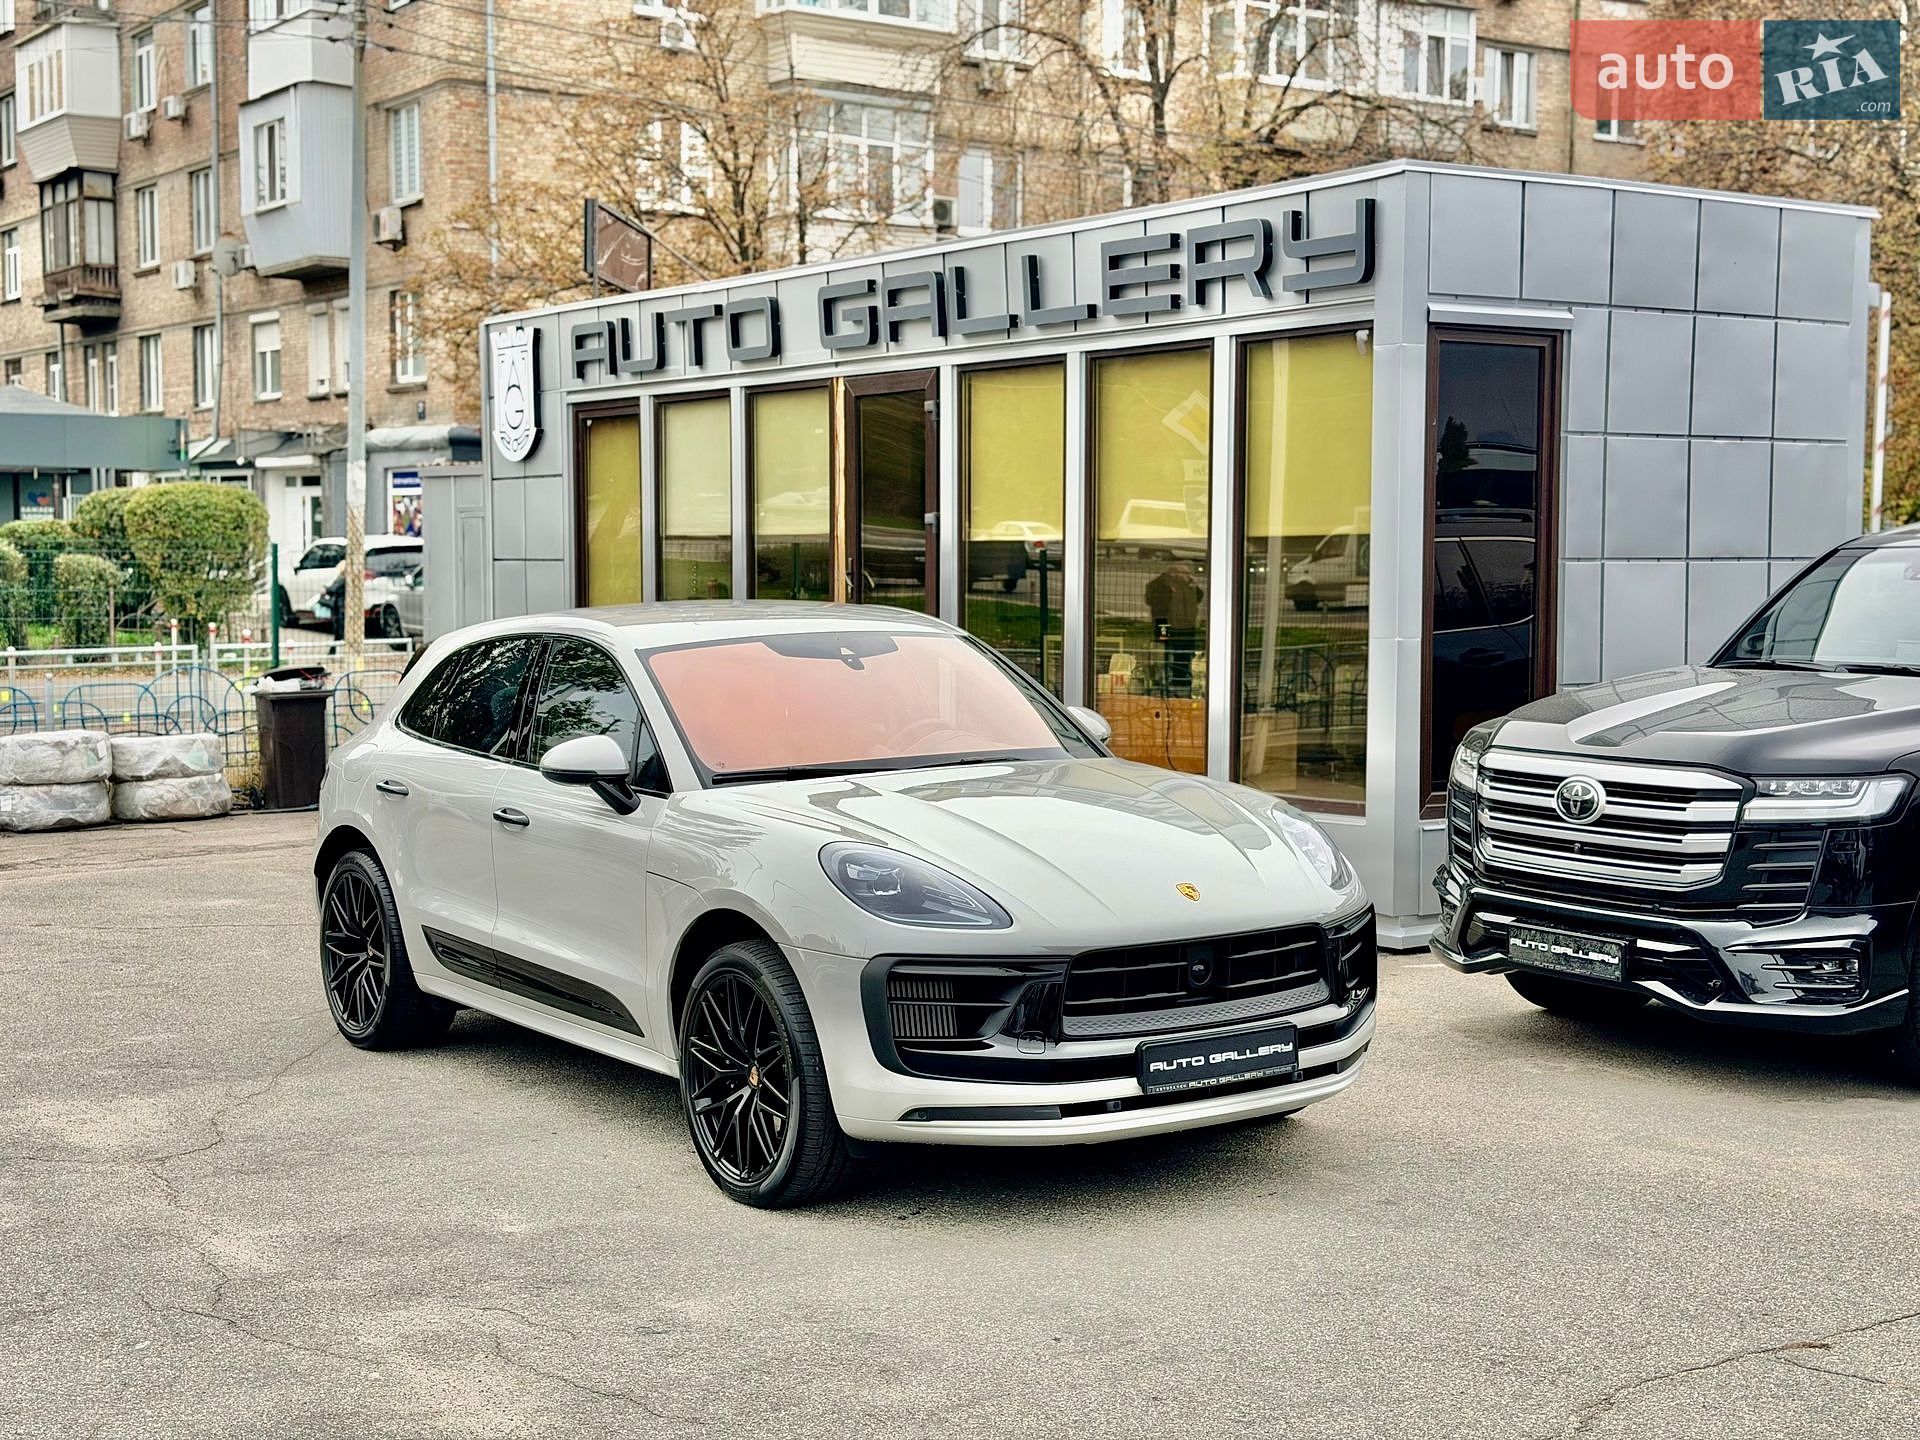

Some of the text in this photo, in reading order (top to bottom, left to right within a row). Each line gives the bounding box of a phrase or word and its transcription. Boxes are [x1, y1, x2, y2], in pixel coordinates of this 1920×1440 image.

[570, 197, 1376, 380] AUTO GALLERY
[1510, 937, 1549, 952] AUTO
[1550, 945, 1619, 964] GALLERY
[1149, 1042, 1293, 1073] AUTO GALLERY
[1188, 1078, 1217, 1088] AUTO
